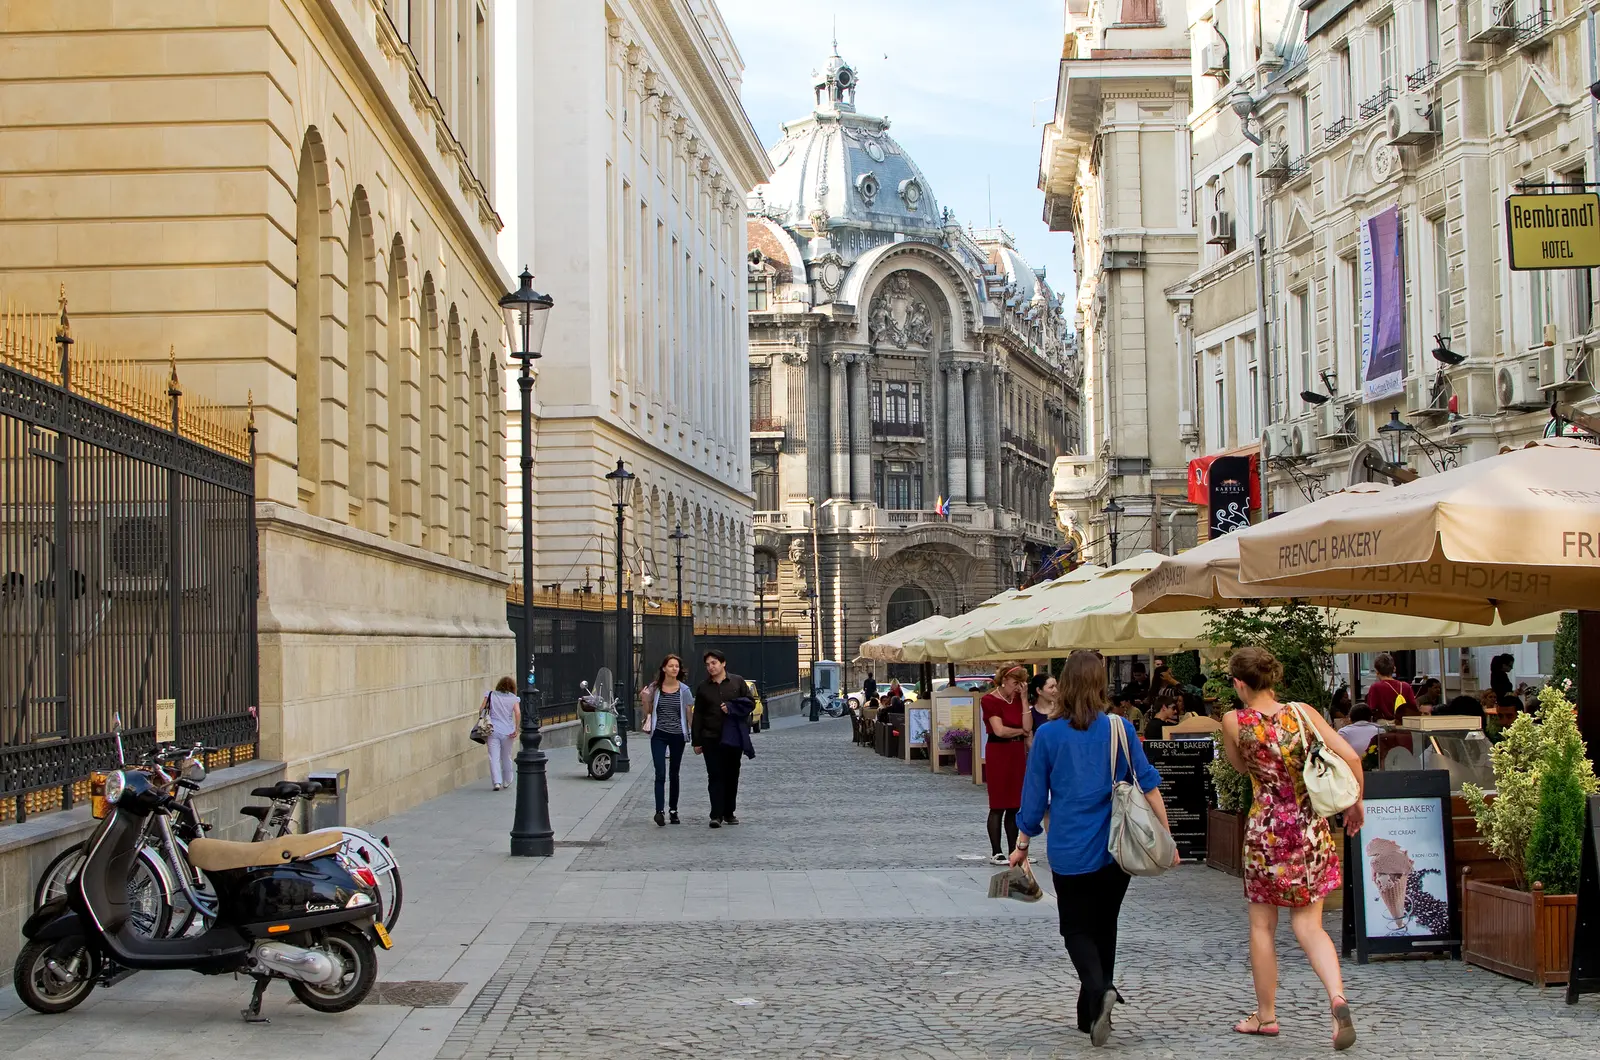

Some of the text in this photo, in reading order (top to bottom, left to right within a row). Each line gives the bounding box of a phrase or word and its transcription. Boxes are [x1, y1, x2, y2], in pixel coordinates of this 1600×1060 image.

[1542, 240, 1573, 259] HOTEL
[1279, 530, 1382, 569] FRENCH BAKERY
[1562, 531, 1600, 558] FR
[1366, 804, 1436, 814] FRENCH BAKERY
[306, 900, 340, 913] Vespa
